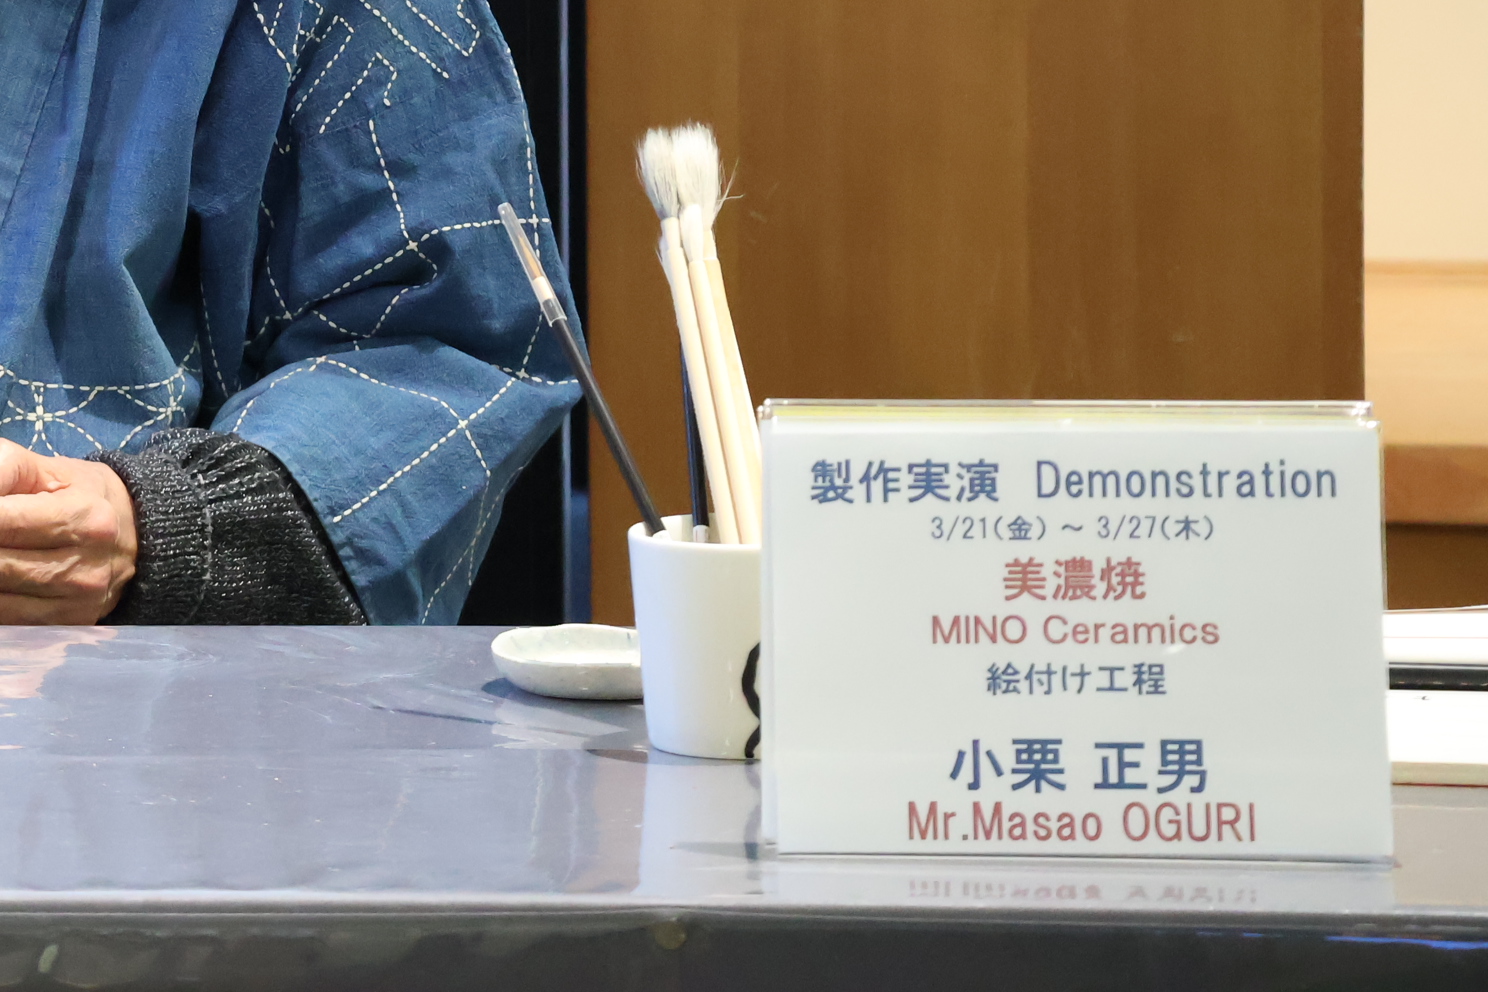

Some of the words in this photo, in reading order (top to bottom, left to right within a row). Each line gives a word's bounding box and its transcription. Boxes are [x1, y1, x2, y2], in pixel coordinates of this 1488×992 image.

[810, 458, 1000, 505] 製作実演
[1036, 458, 1337, 499] Demonstration
[1002, 556, 1147, 602] 美濃焼
[931, 614, 1028, 645] MINO
[1043, 614, 1220, 645] Ceramics
[986, 661, 1168, 696] 絵付け工程
[949, 738, 1067, 794] 小栗
[1093, 738, 1208, 795] 正男
[907, 800, 1103, 842] Mr.Masao
[1122, 801, 1256, 843] OGURI
